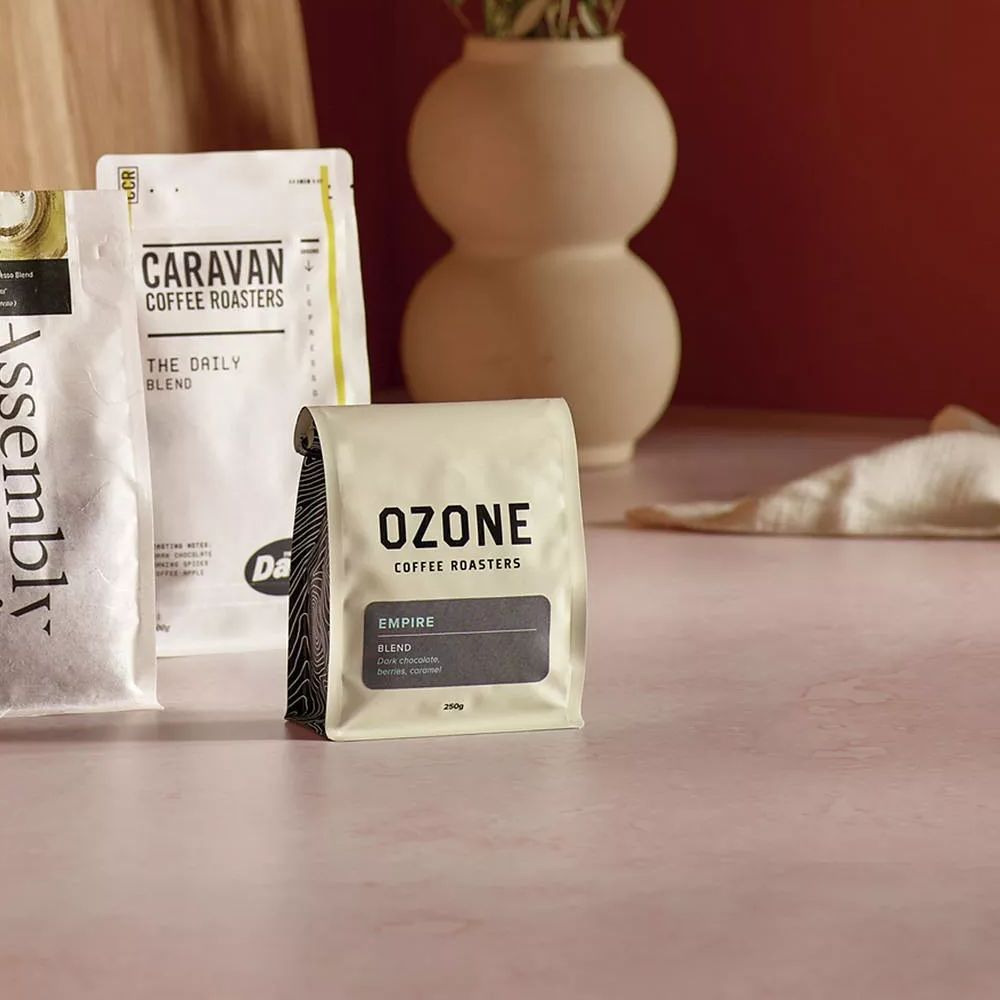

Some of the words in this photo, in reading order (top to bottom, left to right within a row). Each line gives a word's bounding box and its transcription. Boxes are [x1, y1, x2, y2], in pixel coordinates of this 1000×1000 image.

[15, 271, 34, 279] Blend
[142, 248, 284, 289] CARAVAN
[146, 291, 205, 312] COFFEE
[211, 288, 284, 309] ROASTERS
[147, 358, 180, 373] THE
[190, 356, 241, 372] DAILY
[146, 377, 193, 391] BLEND
[378, 503, 532, 550] OZONE
[252, 554, 291, 582] Da
[394, 560, 444, 573] COFFEE
[450, 557, 521, 572] ROASTERS
[378, 616, 435, 630] EMPIRE
[377, 643, 412, 653] BLEND
[376, 656, 397, 665] Dark
[398, 656, 440, 665] chocolate,
[376, 667, 408, 676] berries,
[409, 665, 444, 675] caramel
[443, 702, 465, 712] 250g
